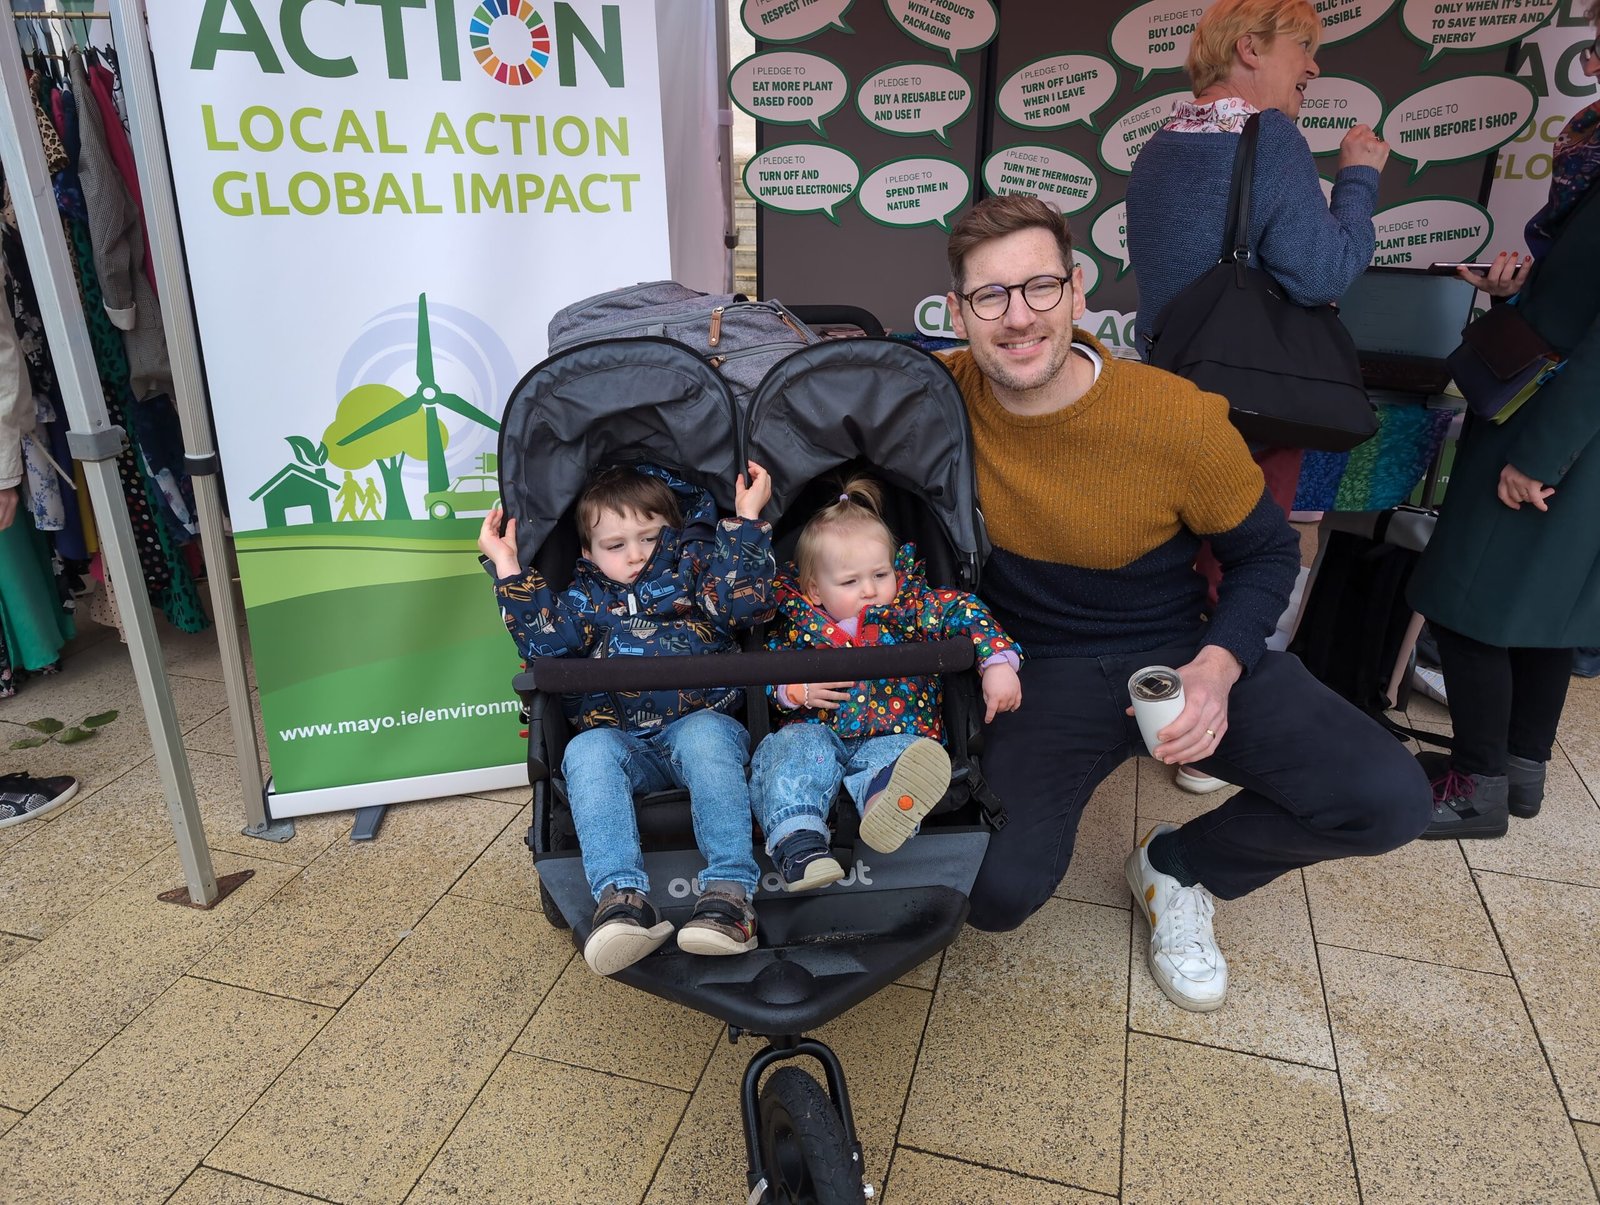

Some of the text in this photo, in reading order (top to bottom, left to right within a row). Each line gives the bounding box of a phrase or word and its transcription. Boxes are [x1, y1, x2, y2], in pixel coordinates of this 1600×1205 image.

[760, 0, 800, 26] RESPECT
[908, 1, 952, 24] WITH LESS
[1434, 3, 1464, 14] ONLY
[1466, 0, 1499, 12] WHEN
[1154, 11, 1188, 23] PLEDGE
[1191, 8, 1203, 17] TO
[1321, 6, 1362, 28] OSSIBLE
[1432, 20, 1445, 29] TO
[1448, 17, 1476, 28] SAVE
[1480, 14, 1518, 26] WATER
[1519, 12, 1545, 24] AND
[902, 15, 952, 40] PACKAGING
[1148, 23, 1198, 40] BUY LOCA
[1432, 32, 1476, 44] ENERGY
[1148, 42, 1176, 54] FOOD
[758, 67, 792, 76] PLEDGE
[794, 67, 806, 75] TO
[1025, 66, 1057, 79] PLEDGE
[1059, 63, 1070, 72] TO
[752, 82, 834, 92] EAT MORE PLANT
[878, 78, 909, 88] PLEDGE
[911, 78, 922, 86] TO
[1021, 70, 1098, 94] TURN OFF LIGHTS
[753, 96, 814, 106] BASED FOOD
[874, 90, 966, 105] BUY A REUSABLE CUP
[1023, 94, 1050, 108] WHEN
[1058, 86, 1086, 101] LEAVE
[1300, 99, 1348, 110] EDGE TO
[874, 109, 922, 121] AND USE IT
[1024, 103, 1070, 121] THE ROOM
[1123, 111, 1150, 126] PLEDGE
[1152, 106, 1162, 114] TO
[1406, 106, 1443, 122] PLEDGE
[1446, 104, 1458, 114] TO
[1302, 116, 1358, 129] ORGANIC
[1400, 127, 1431, 144] THINK
[1434, 119, 1476, 138] BEFORE
[1486, 112, 1518, 129] SHOP
[201, 104, 630, 158] LOCAL ACTION
[1123, 130, 1138, 142] GET
[764, 157, 794, 165] PLEDGE
[796, 156, 806, 164] TO
[1011, 151, 1038, 162] PLEDGE
[1040, 156, 1050, 164] TO
[759, 170, 820, 182] TURN OFF AND
[890, 173, 920, 184] PLEDGE
[922, 172, 933, 180] TO
[1004, 162, 1093, 186] TURN THE THERMOSTAT
[212, 170, 640, 218] GLOBAL IMPACT
[760, 184, 852, 196] UNPLUG ELECTRONICS
[886, 182, 949, 198] SPEND TIME IN
[998, 187, 1007, 196] IN
[1001, 175, 1089, 199] DOWN BY ONE DEGREE
[887, 199, 921, 212] NATURE
[1378, 219, 1429, 234] PLEDGE TO
[1374, 226, 1481, 251] PLANT BEE FRIENDLY
[1374, 252, 1412, 266] PLANTS
[279, 699, 524, 742] www.mayo.ie/environm
